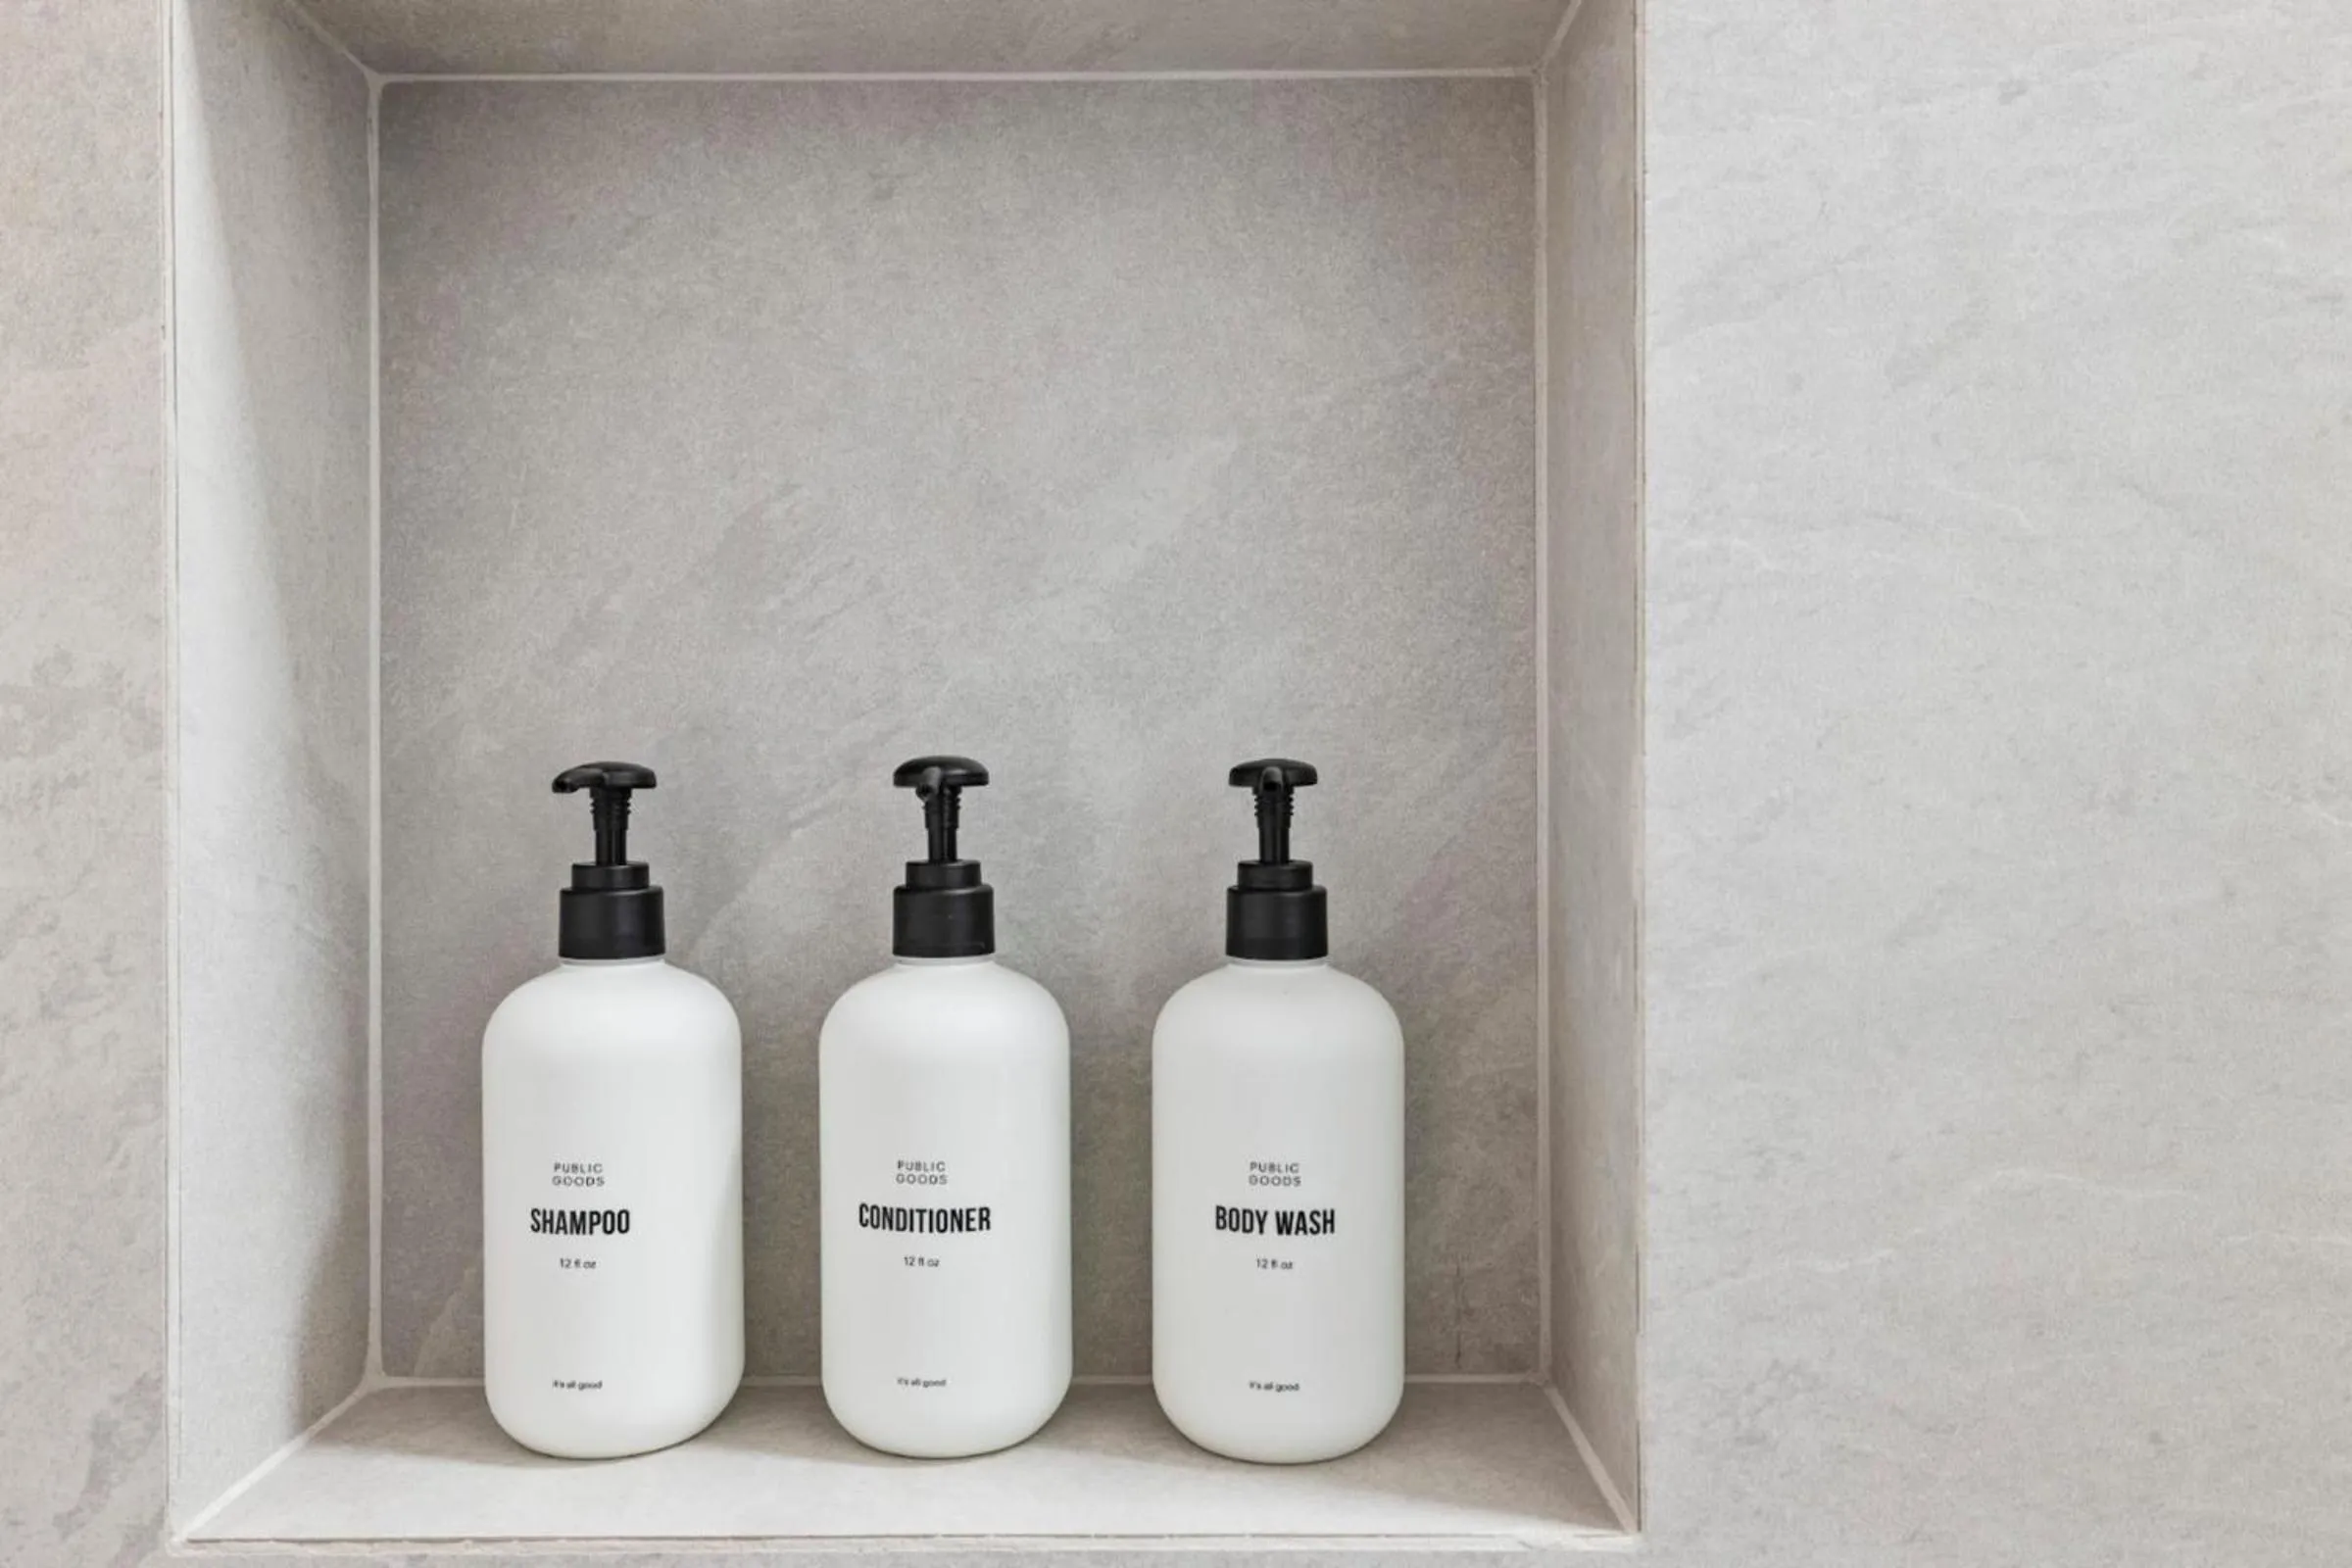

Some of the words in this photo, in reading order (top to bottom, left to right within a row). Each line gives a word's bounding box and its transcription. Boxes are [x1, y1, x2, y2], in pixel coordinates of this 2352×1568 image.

[553, 1162, 604, 1174] PUBLIC
[897, 1160, 946, 1172] PUBLIC
[1249, 1161, 1299, 1174] PUBLIC
[551, 1176, 606, 1187] GOODS
[896, 1173, 948, 1185] GOODS
[1248, 1175, 1301, 1187] GOODS
[529, 1207, 631, 1236] SHAMPOO
[858, 1202, 992, 1234] CONDITIONER
[1214, 1204, 1269, 1236] BODY
[1274, 1207, 1336, 1236] WASH
[560, 1257, 572, 1269] 12
[582, 1260, 597, 1270] oz
[903, 1255, 915, 1267] 12
[926, 1258, 941, 1268] oz
[1255, 1257, 1268, 1269] 12
[577, 1380, 604, 1392] good
[1274, 1381, 1300, 1394] good
